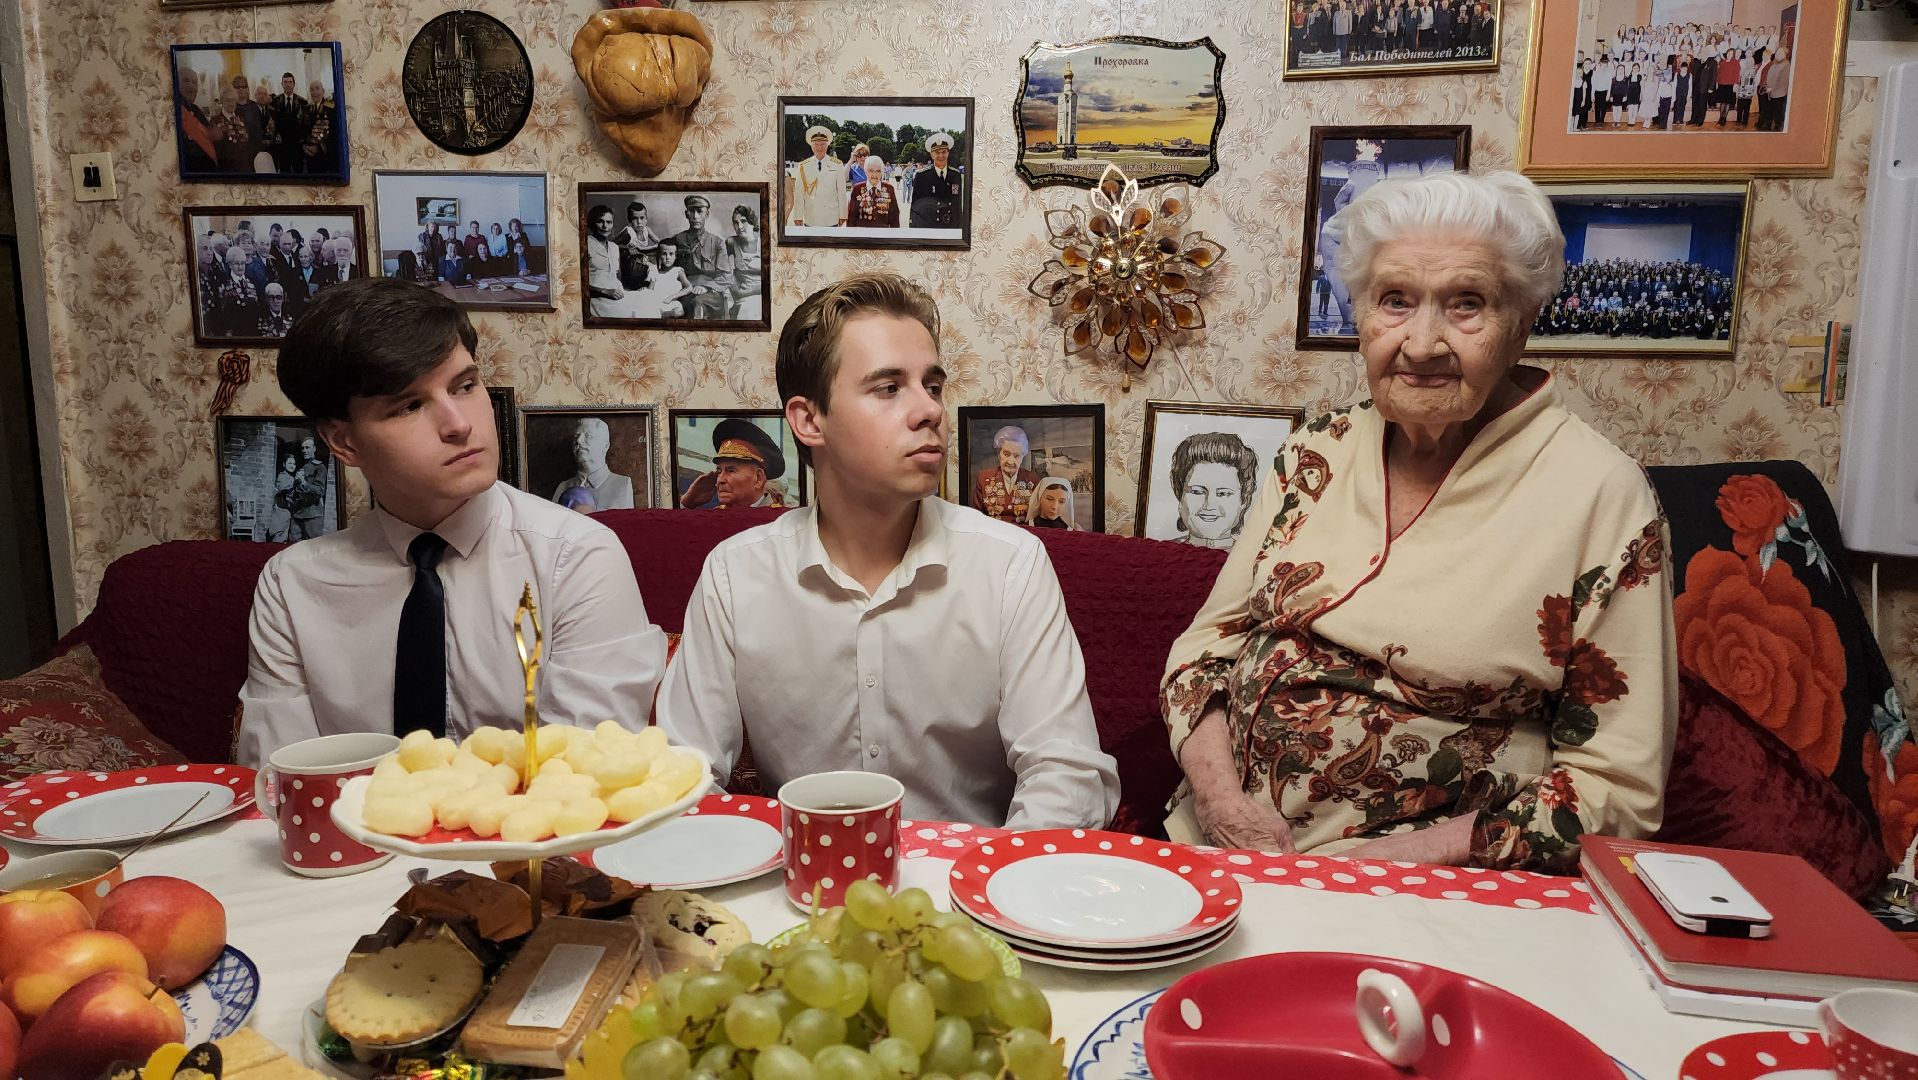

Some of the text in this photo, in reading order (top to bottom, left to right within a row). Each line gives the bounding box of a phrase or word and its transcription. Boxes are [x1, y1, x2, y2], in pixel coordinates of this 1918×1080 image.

[1350, 51, 1372, 62] Бал
[1374, 47, 1453, 61] Победителей
[1094, 55, 1149, 69] Прохоровка
